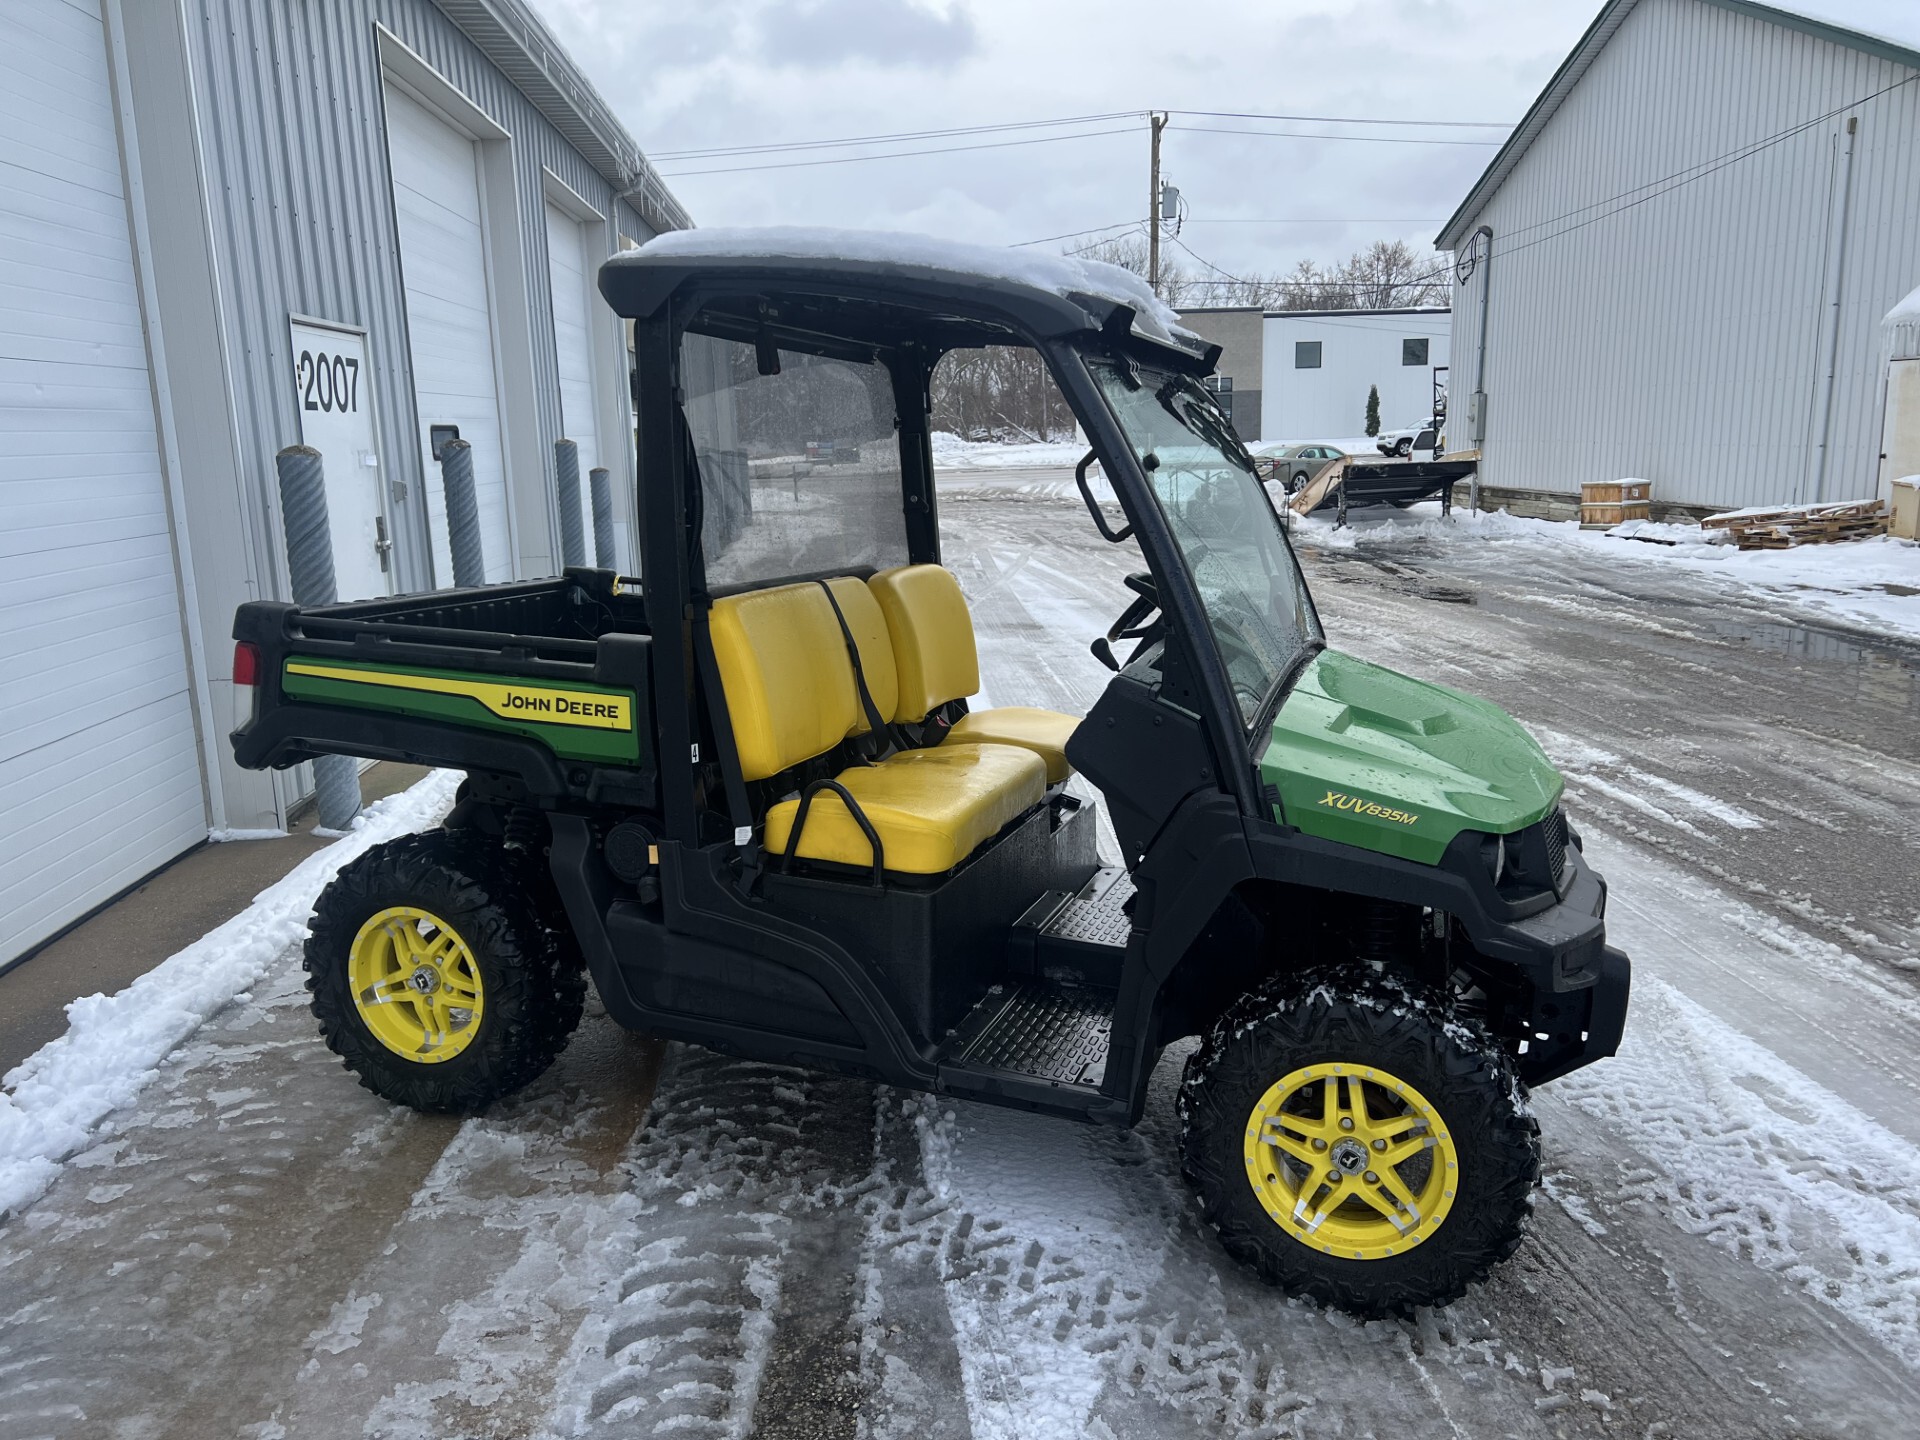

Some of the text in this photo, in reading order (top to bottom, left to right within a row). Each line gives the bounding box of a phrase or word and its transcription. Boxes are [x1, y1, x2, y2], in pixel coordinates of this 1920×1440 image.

[301, 350, 358, 413] 2007
[502, 692, 619, 719] JOHN DEERE
[1318, 791, 1418, 825] XUV835M
